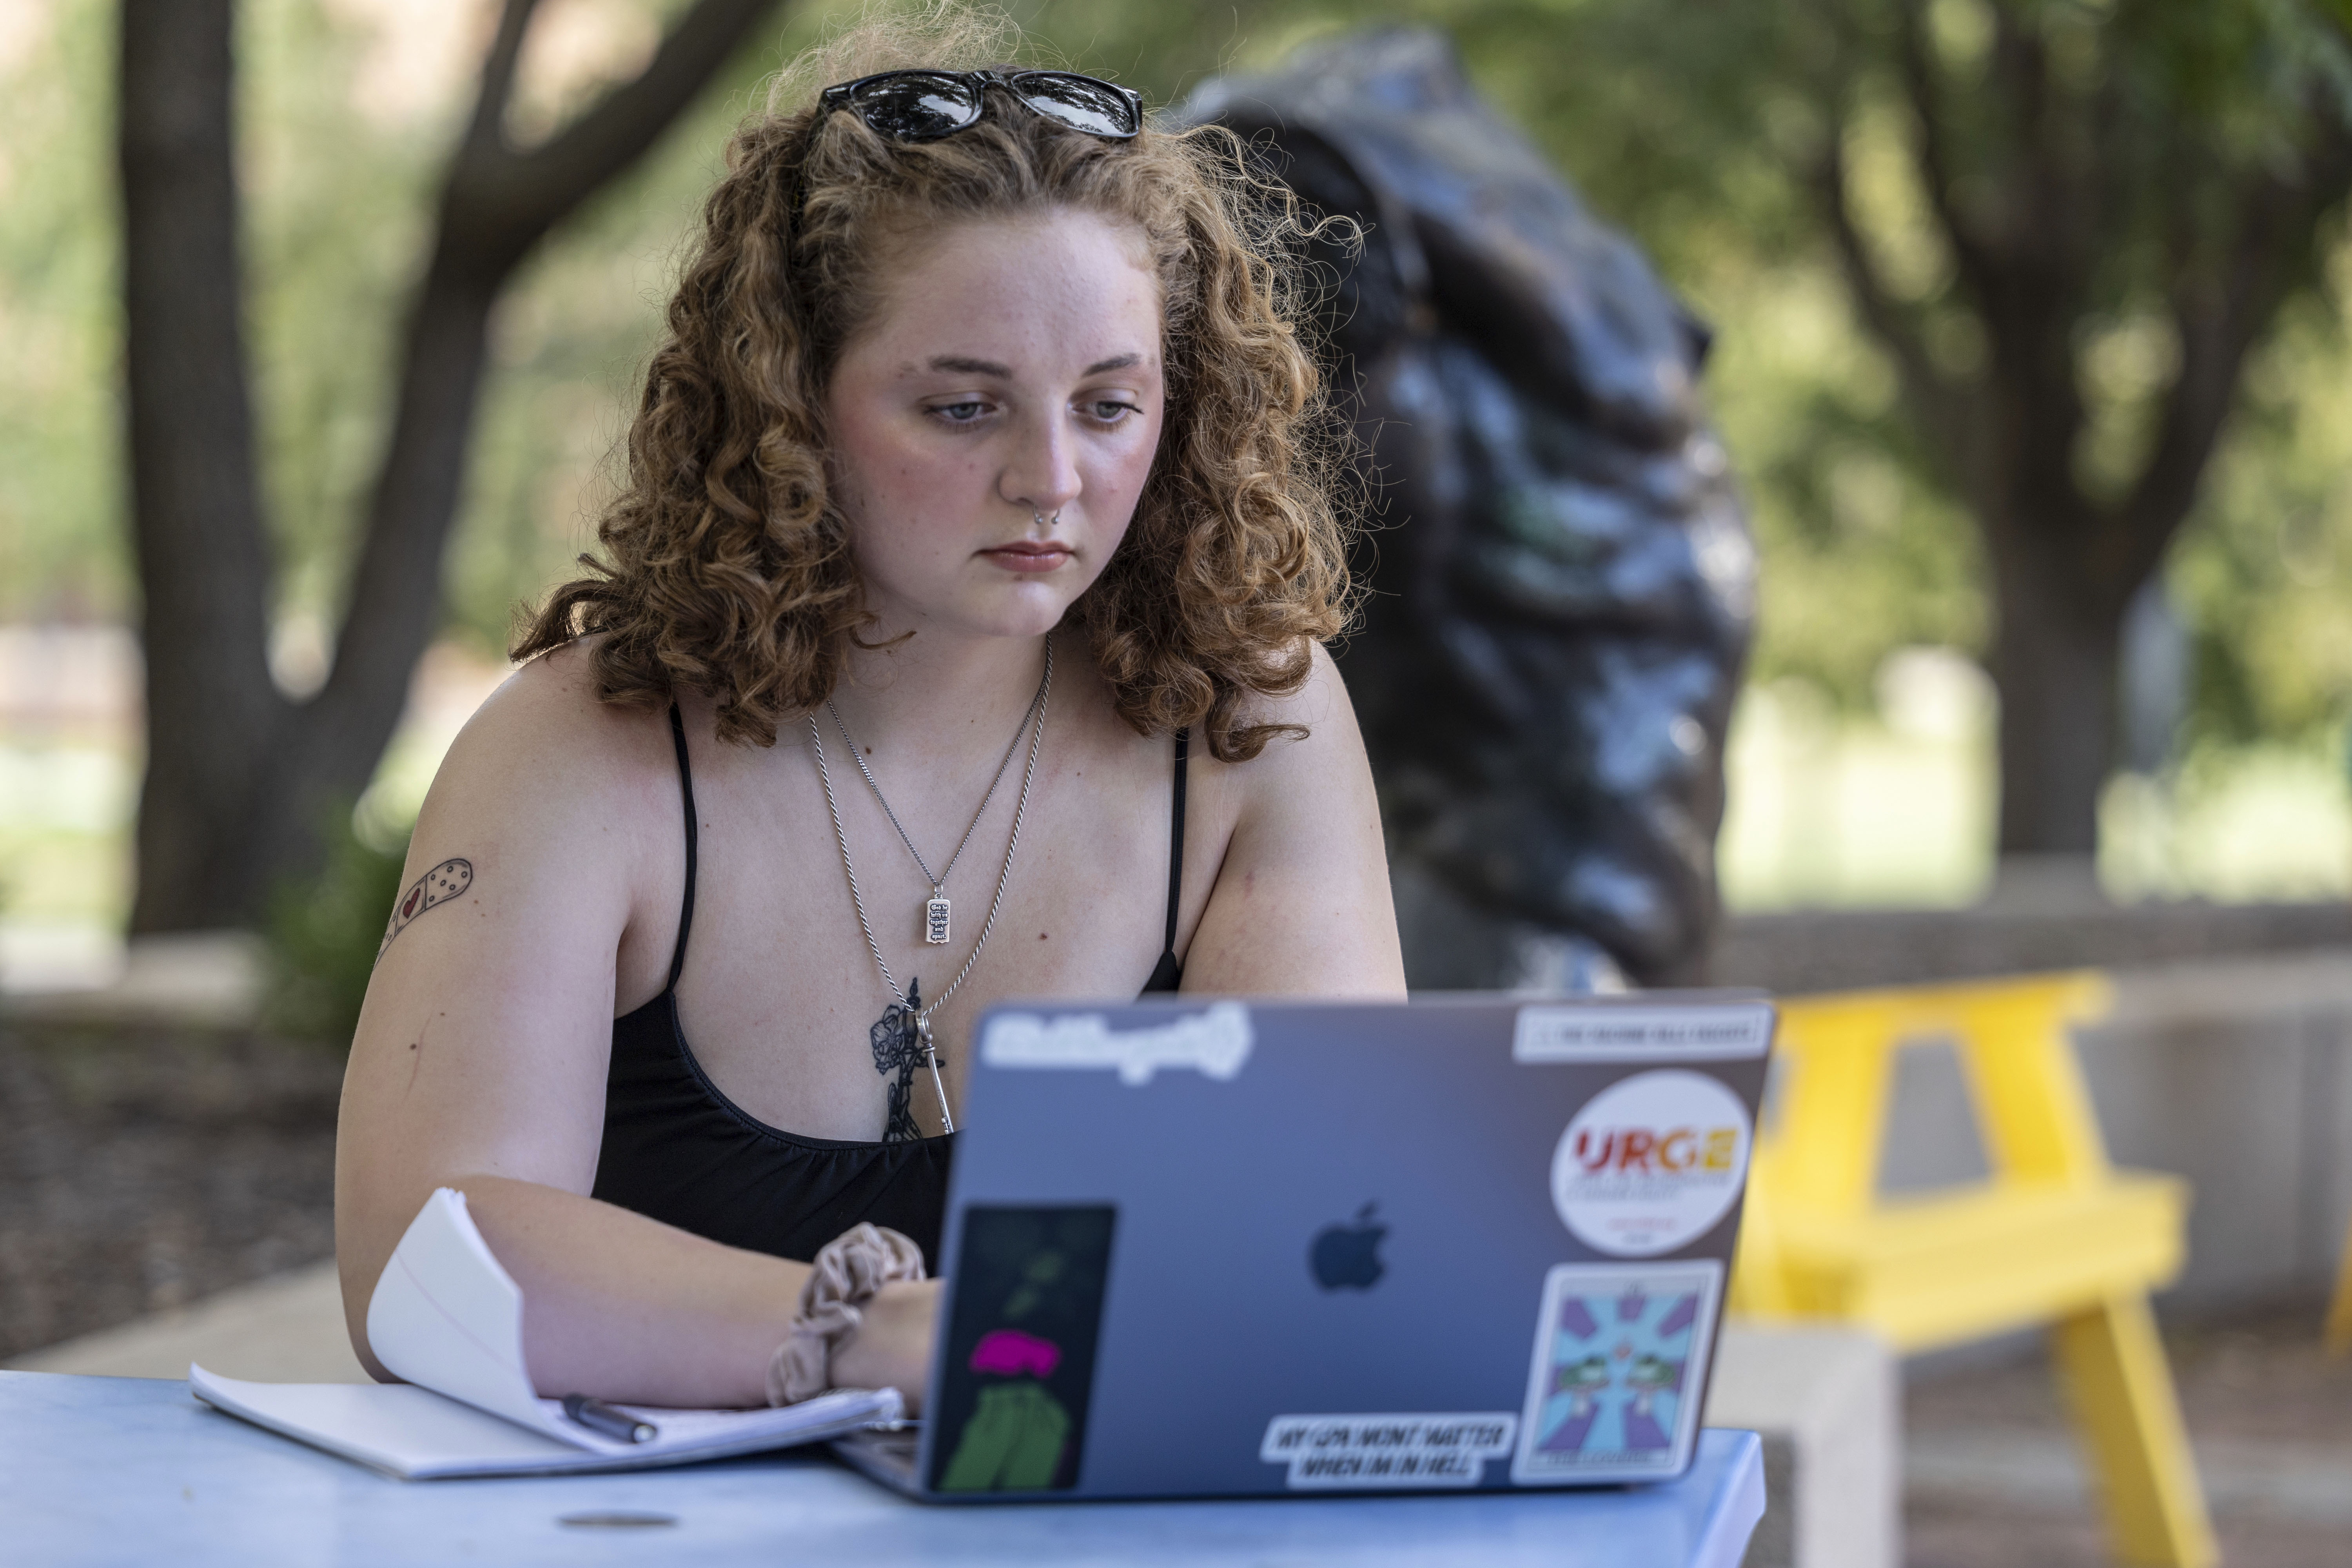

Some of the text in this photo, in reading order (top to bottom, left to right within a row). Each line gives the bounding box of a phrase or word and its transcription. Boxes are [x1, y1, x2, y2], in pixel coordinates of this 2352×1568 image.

[1576, 1127, 1737, 1174] URGE
[1277, 1426, 1309, 1449] MY
[1423, 1424, 1506, 1447] MATTER
[1301, 1454, 1364, 1477] WHEN
[1422, 1453, 1470, 1476] HELL
